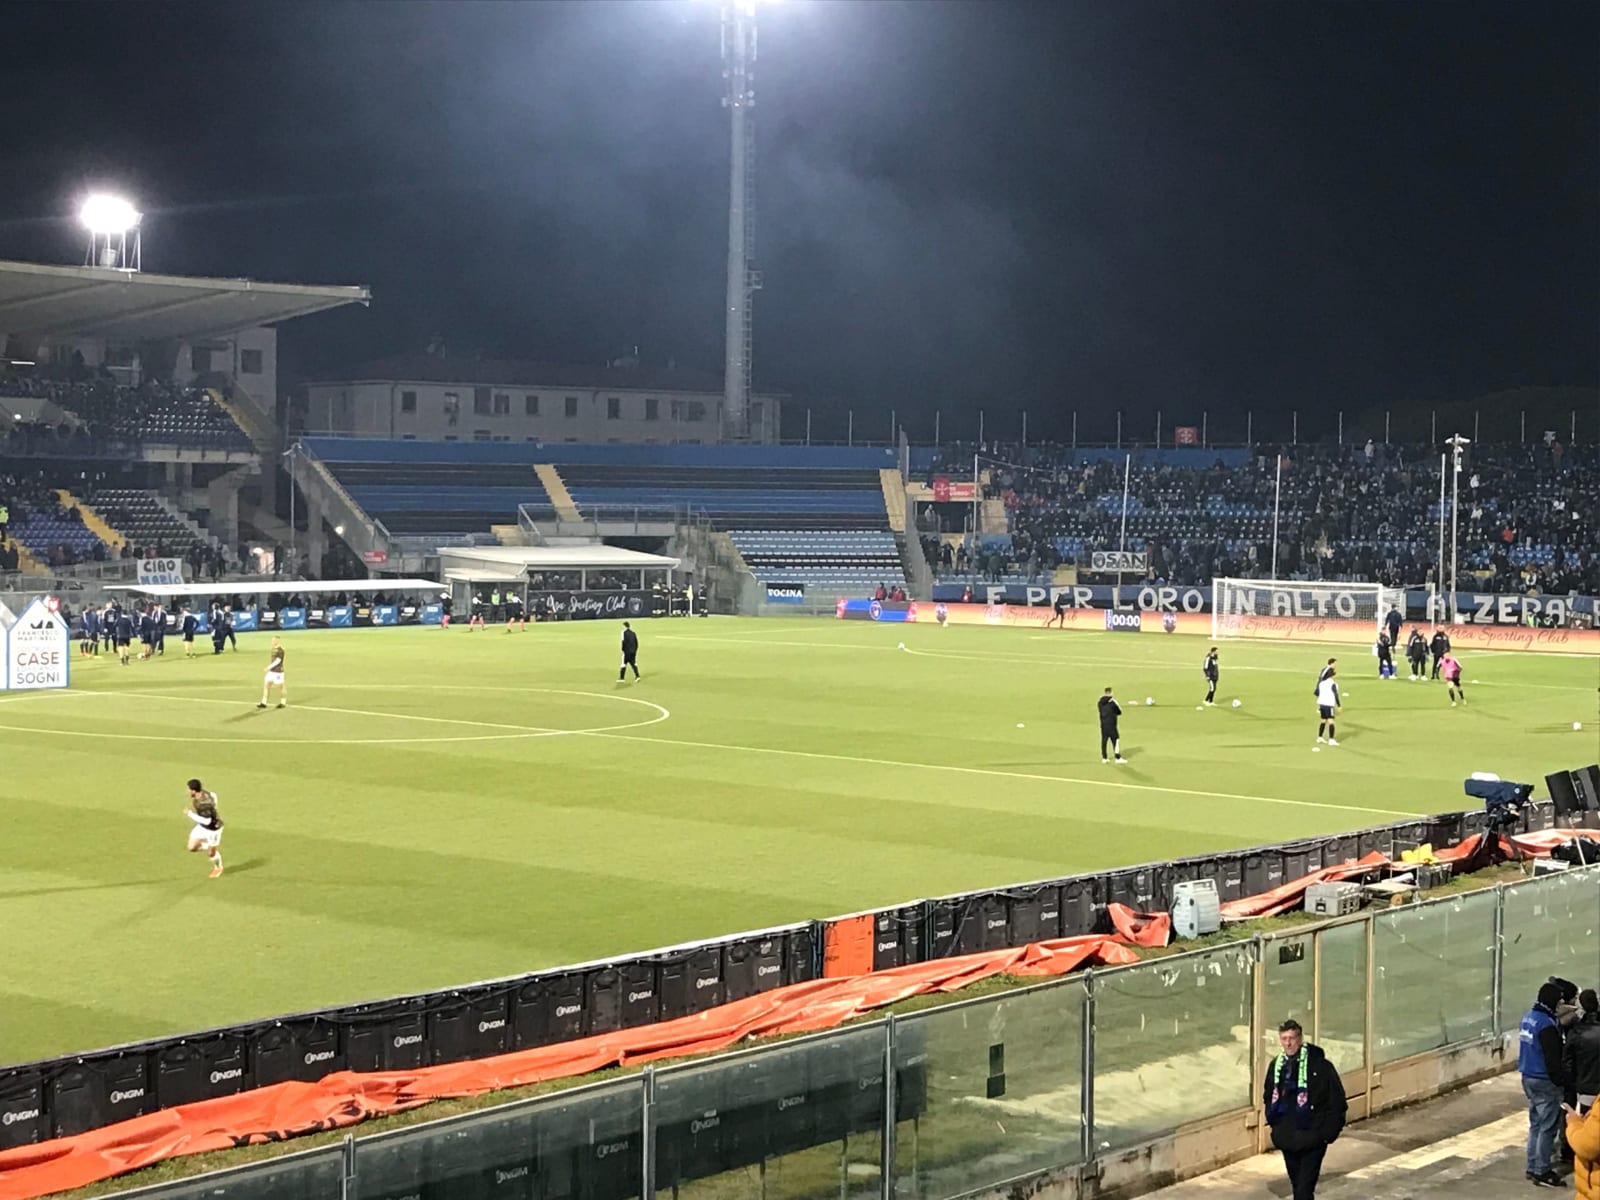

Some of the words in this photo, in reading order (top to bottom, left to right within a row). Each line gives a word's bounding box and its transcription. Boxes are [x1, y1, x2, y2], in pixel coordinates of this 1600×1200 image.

[143, 560, 176, 573] CIAO
[987, 586, 1007, 606] E
[1026, 586, 1094, 609] PER
[1112, 587, 1204, 613] LORO
[1224, 588, 1257, 616] IN
[1271, 590, 1356, 618] ALTO
[1112, 614, 1140, 627] 00:00
[1478, 627, 1534, 650] Sporting
[1537, 628, 1569, 644] Club
[17, 652, 59, 666] CASE
[17, 672, 60, 684] SOGNI
